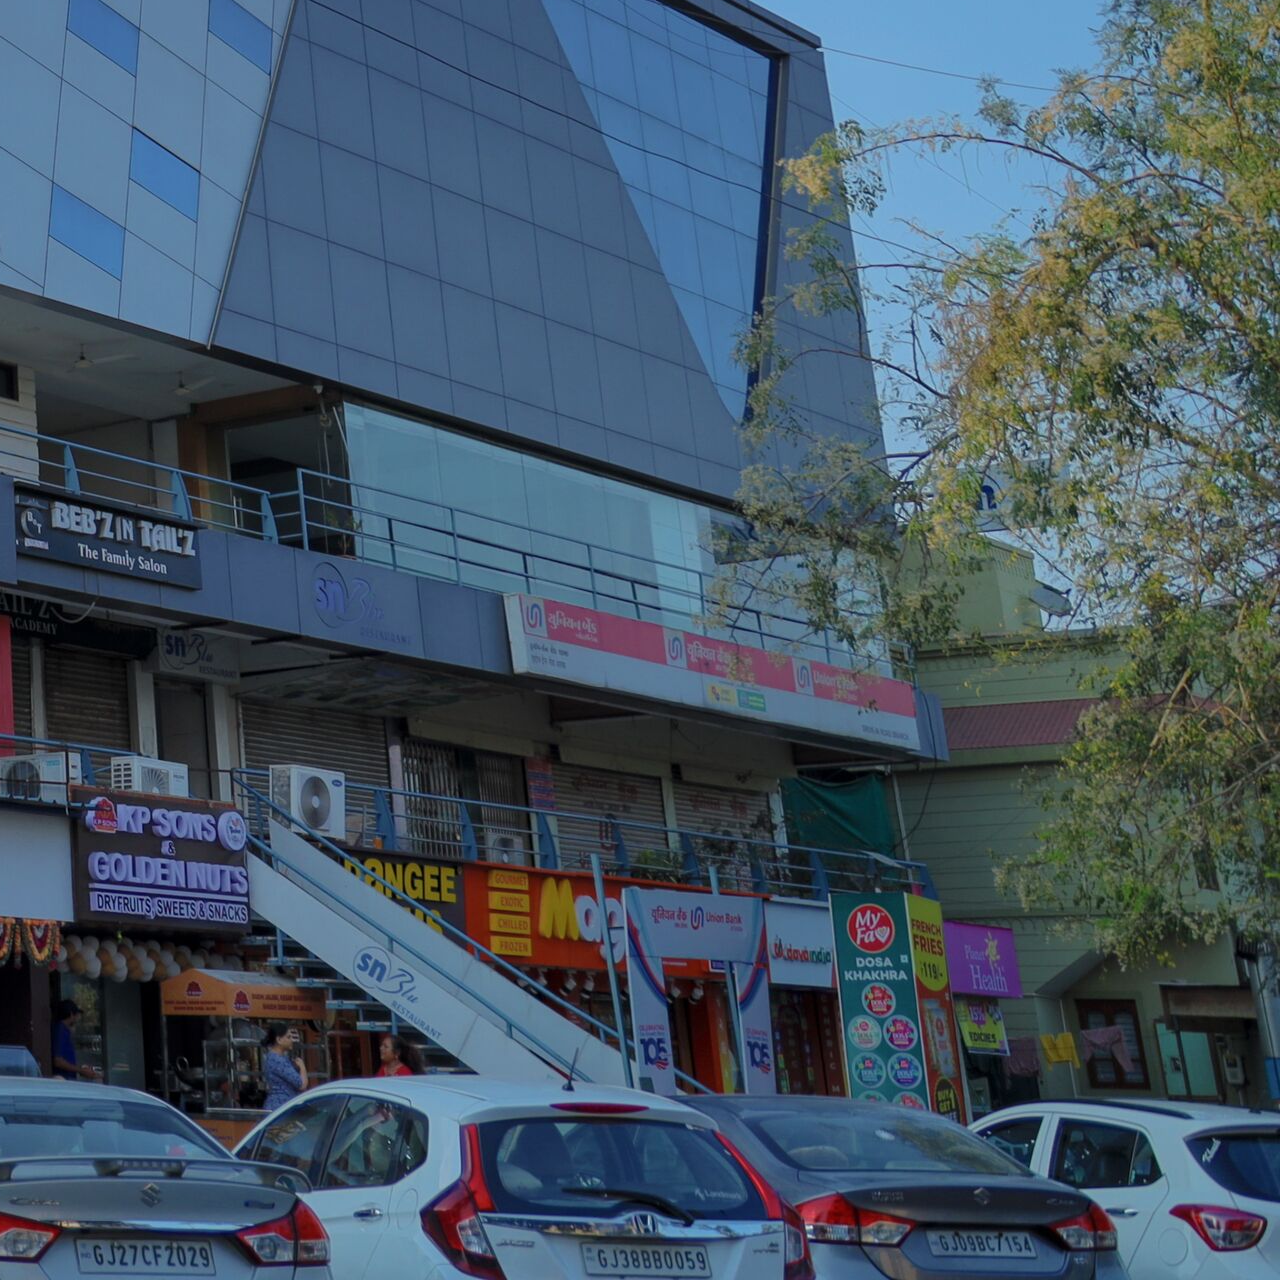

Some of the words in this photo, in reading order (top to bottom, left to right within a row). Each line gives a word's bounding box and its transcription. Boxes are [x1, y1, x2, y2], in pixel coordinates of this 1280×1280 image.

[51, 500, 113, 539] BEB'Z
[115, 514, 134, 542] IN
[78, 542, 99, 561] The
[101, 548, 135, 572] Family
[138, 556, 168, 574] Salon
[314, 578, 345, 616] sn
[165, 632, 186, 657] sn
[116, 804, 151, 834] KP
[152, 808, 216, 842] SONS
[161, 840, 176, 856] &
[88, 852, 186, 888] GOLDEN
[187, 862, 248, 894] NUTS
[97, 894, 155, 919] DRYFRUITS,
[157, 899, 196, 918] SWEETS
[199, 901, 206, 918] &
[208, 904, 247, 923] SNACKS
[706, 913, 724, 923] Union
[725, 914, 742, 924] Bank
[856, 911, 881, 930] My
[498, 918, 528, 931] CHILLED
[911, 919, 941, 936] FRENCH
[500, 940, 528, 953] FROZEN
[913, 936, 943, 957] FRIES
[856, 957, 892, 967] DOSA
[356, 952, 387, 985] sn
[378, 967, 419, 1006] Blu
[845, 970, 907, 981] KHAKHRA
[970, 964, 1009, 993] Health
[391, 999, 443, 1041] RESTAURANT
[92, 1243, 211, 1268] GJ27CF2029
[939, 1233, 1033, 1256] GJ09BC7154
[597, 1249, 707, 1271] GJ38BB0059
